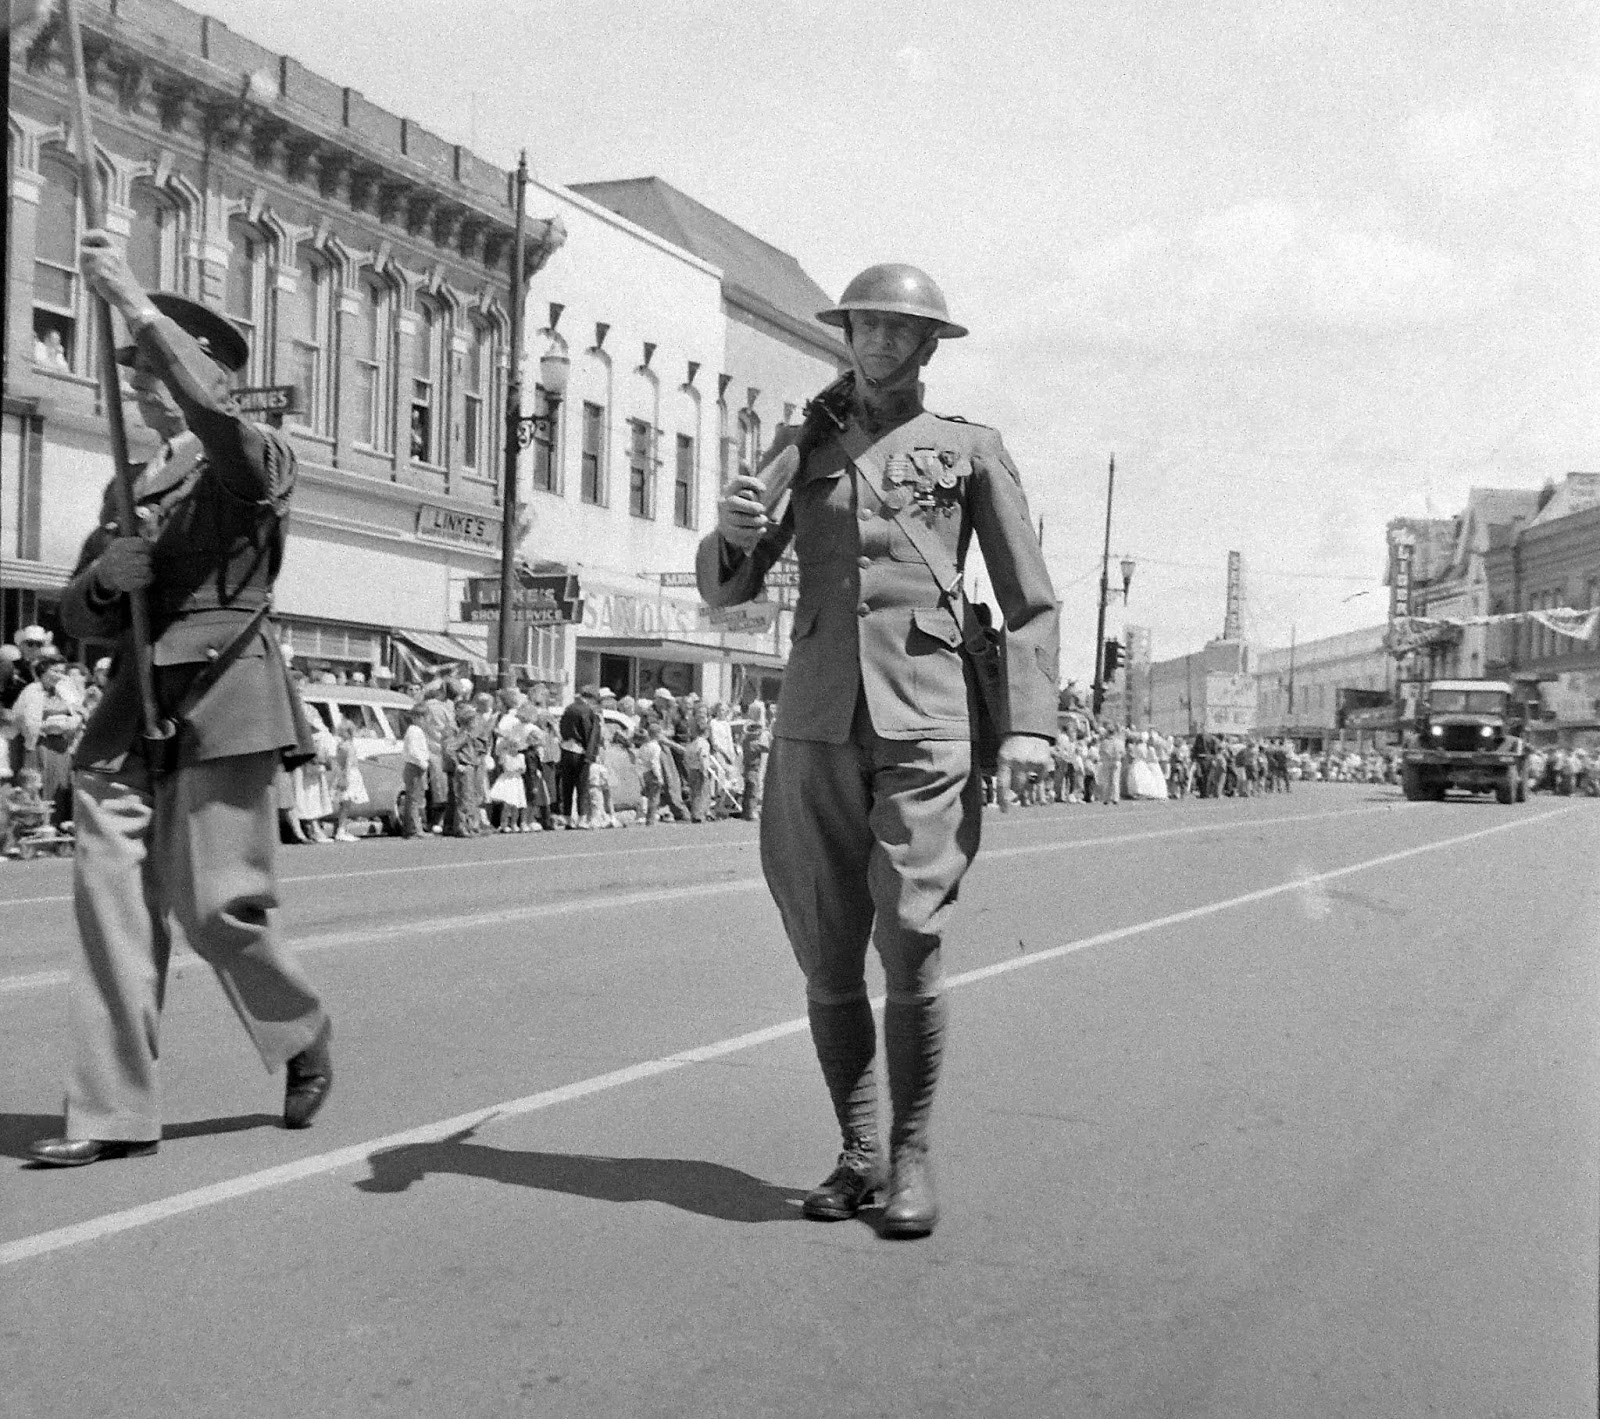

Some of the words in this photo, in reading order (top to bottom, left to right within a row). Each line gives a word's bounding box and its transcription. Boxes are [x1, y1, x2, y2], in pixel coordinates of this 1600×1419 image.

[433, 510, 486, 537] LINKE'S
[1397, 543, 1410, 617] LIBER
[479, 588, 555, 603] LIKE'S
